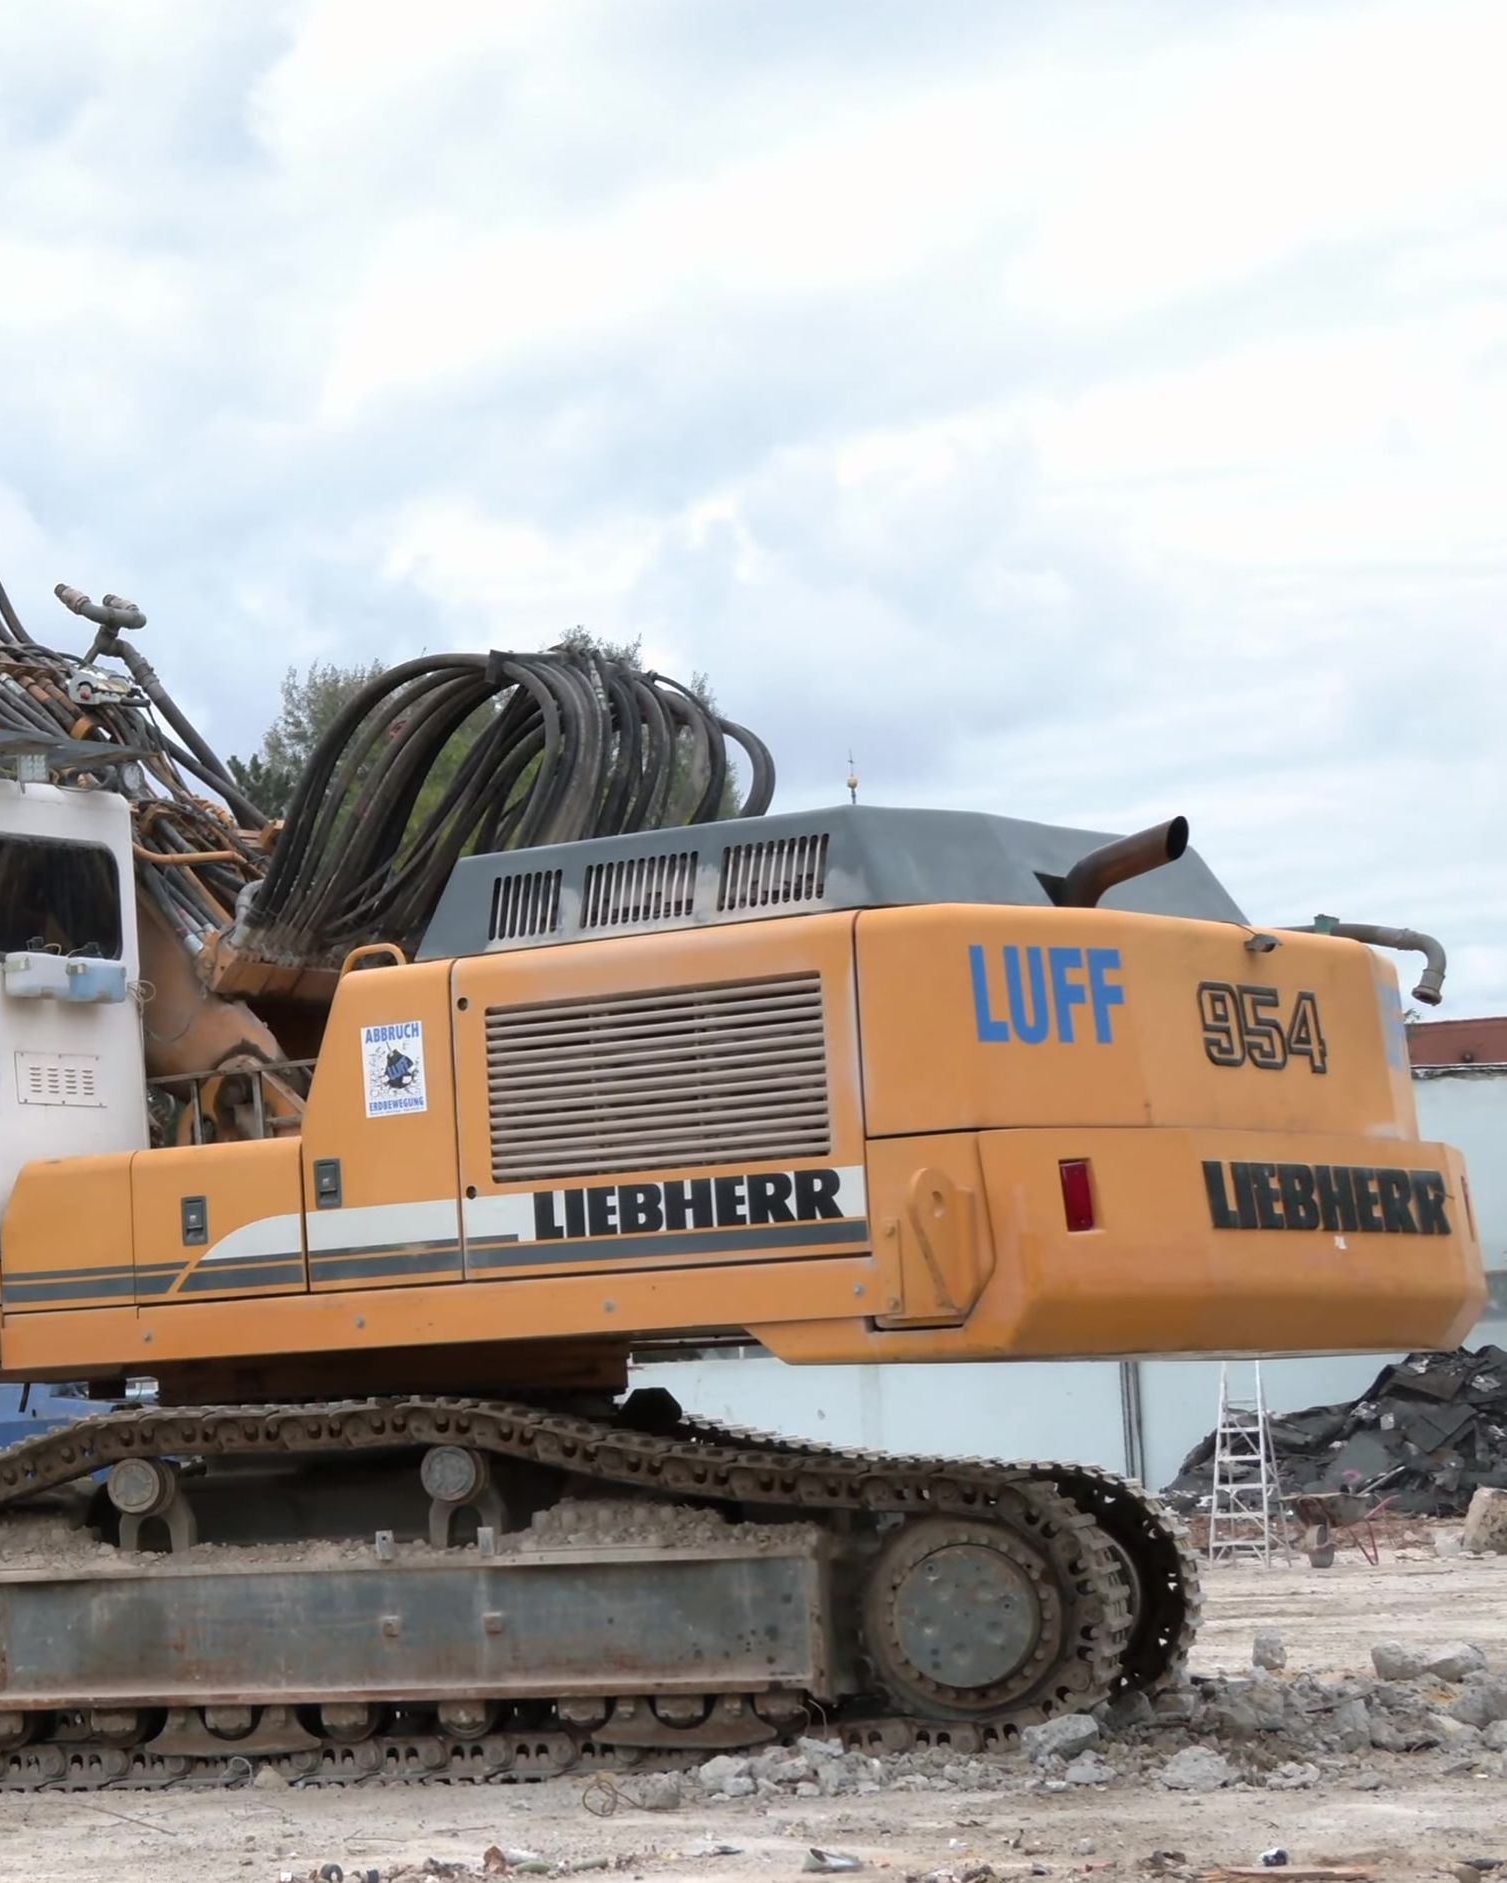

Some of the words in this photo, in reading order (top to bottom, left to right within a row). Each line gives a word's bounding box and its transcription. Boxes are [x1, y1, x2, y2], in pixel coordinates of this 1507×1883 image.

[969, 945, 1124, 1045] LUFF
[1197, 981, 1327, 1074] 954
[365, 1022, 419, 1044] ABBRUCH
[369, 1096, 424, 1112] ERDBEWEGUNG
[533, 1168, 845, 1241] LIEBHERR
[1201, 1160, 1452, 1236] LIEBHERR
